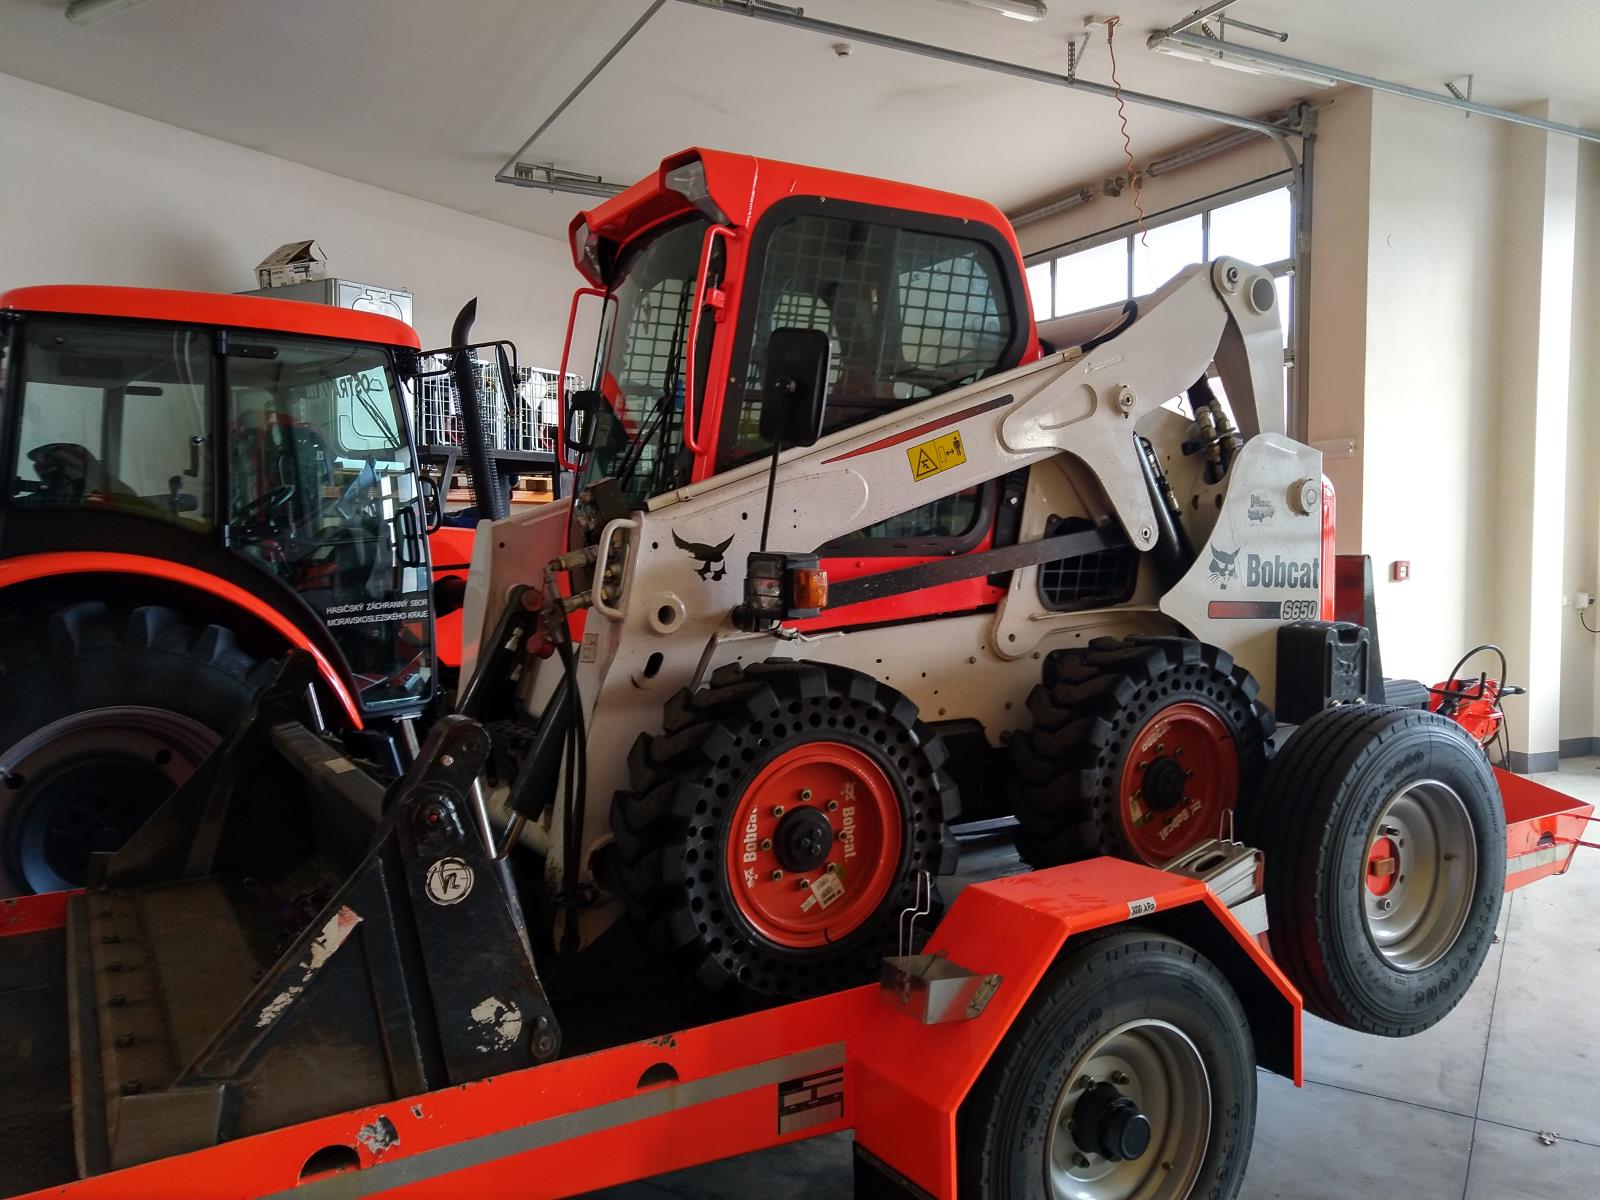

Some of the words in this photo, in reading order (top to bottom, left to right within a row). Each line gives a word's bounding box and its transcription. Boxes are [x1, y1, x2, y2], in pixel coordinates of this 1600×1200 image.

[1247, 554, 1319, 589] Bobcat
[326, 603, 364, 614] HASIČSKÝ
[366, 598, 408, 611] ZÁCHRANNÝ
[409, 598, 428, 608] SBOR
[407, 610, 429, 619] KRAJE
[1282, 600, 1318, 620] S650
